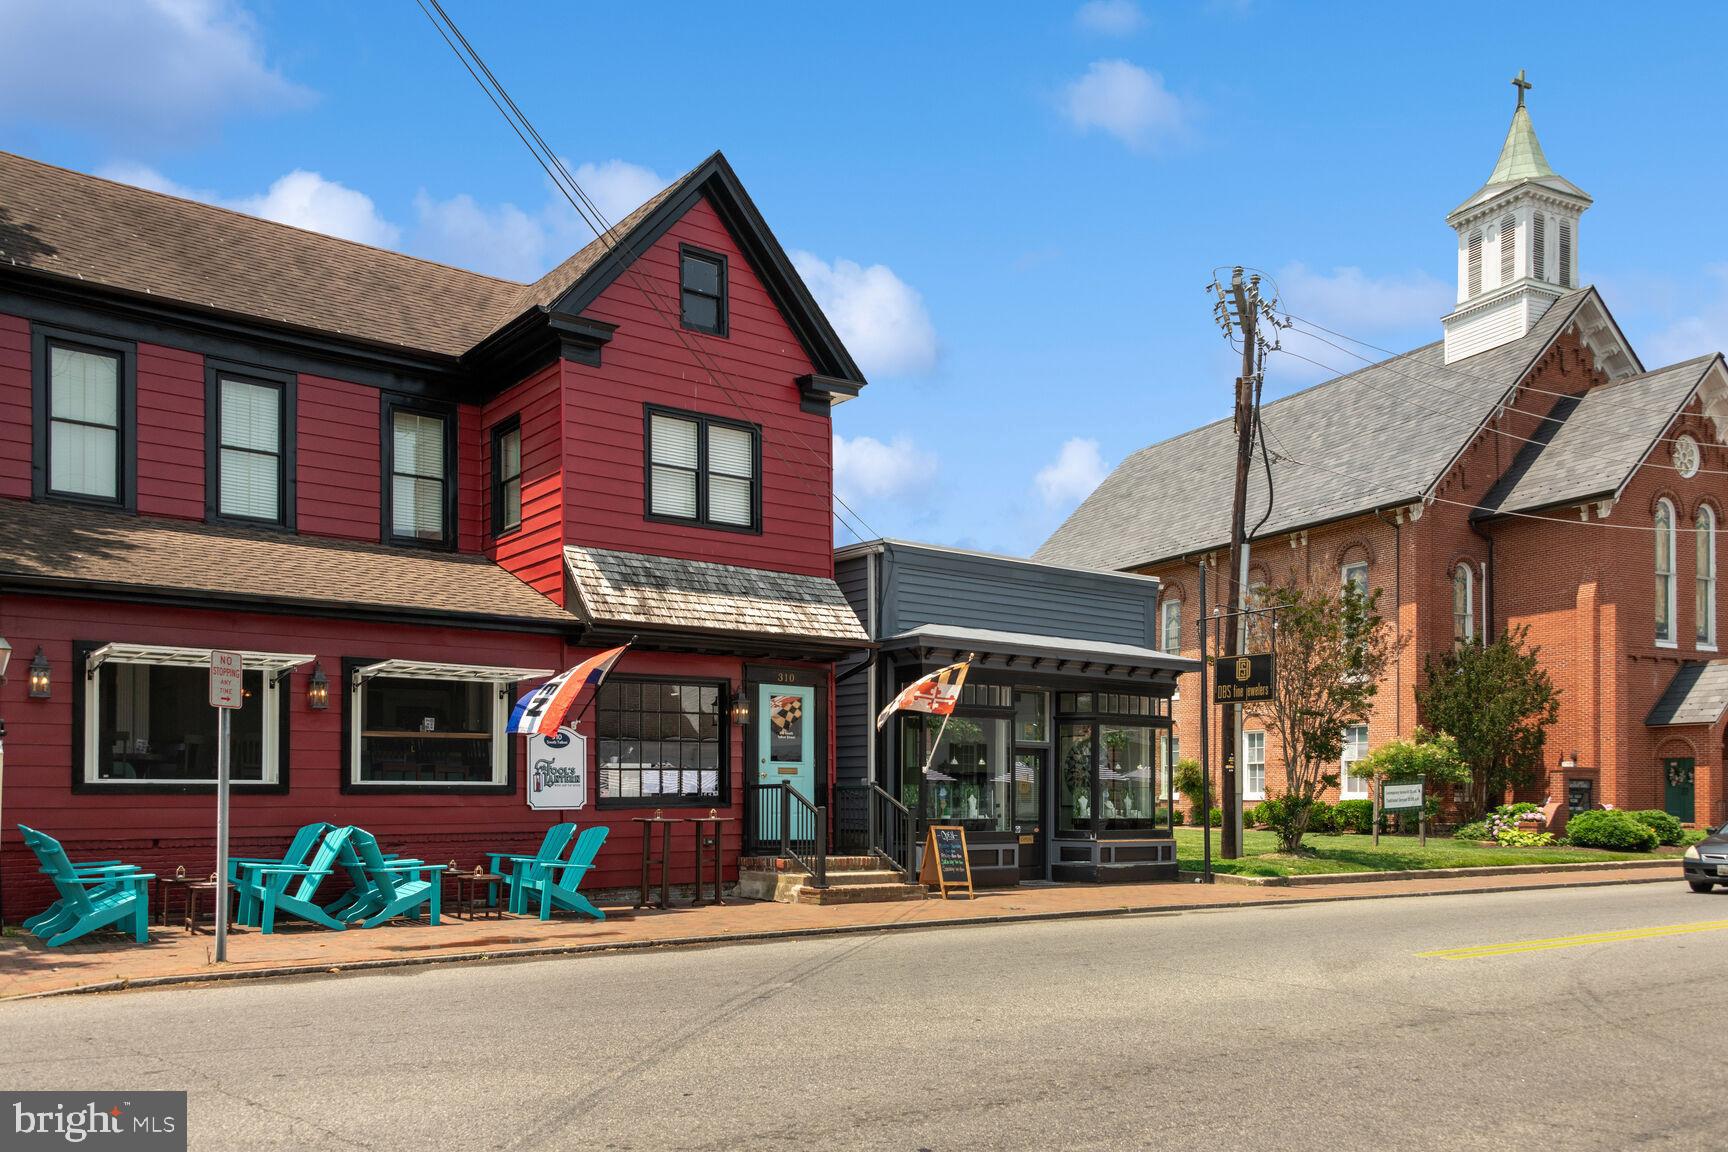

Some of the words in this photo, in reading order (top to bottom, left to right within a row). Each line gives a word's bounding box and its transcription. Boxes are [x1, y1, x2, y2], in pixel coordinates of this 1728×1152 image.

[220, 655, 232, 665] NO
[212, 666, 240, 679] STOPPING
[777, 672, 795, 683] 310
[219, 687, 233, 695] TIME
[1217, 684, 1232, 698] DBS
[1233, 684, 1243, 698] fine
